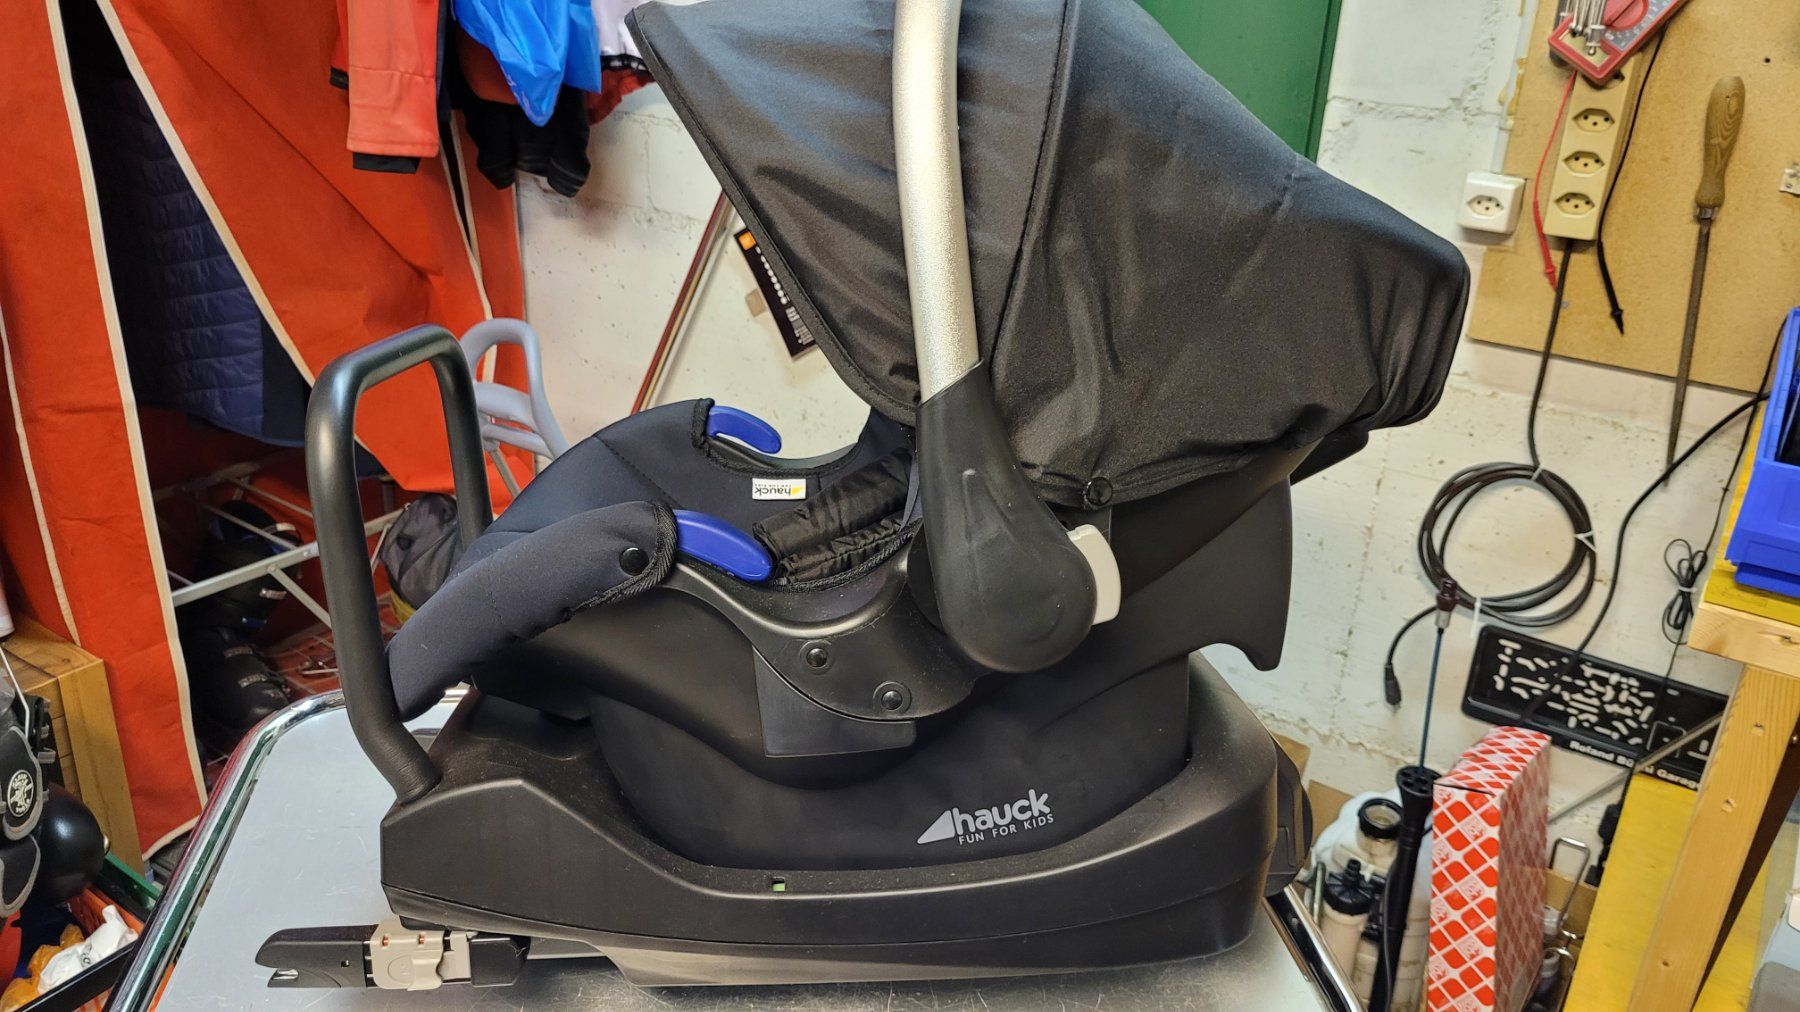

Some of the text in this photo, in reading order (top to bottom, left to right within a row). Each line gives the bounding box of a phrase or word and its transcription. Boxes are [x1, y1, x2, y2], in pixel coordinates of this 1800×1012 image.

[754, 487, 792, 496] hauck
[1569, 740, 1615, 762] Roland
[1656, 768, 1699, 789] Garag
[952, 788, 1051, 835] hauck
[958, 813, 1054, 846] FUN FOR KIDS
